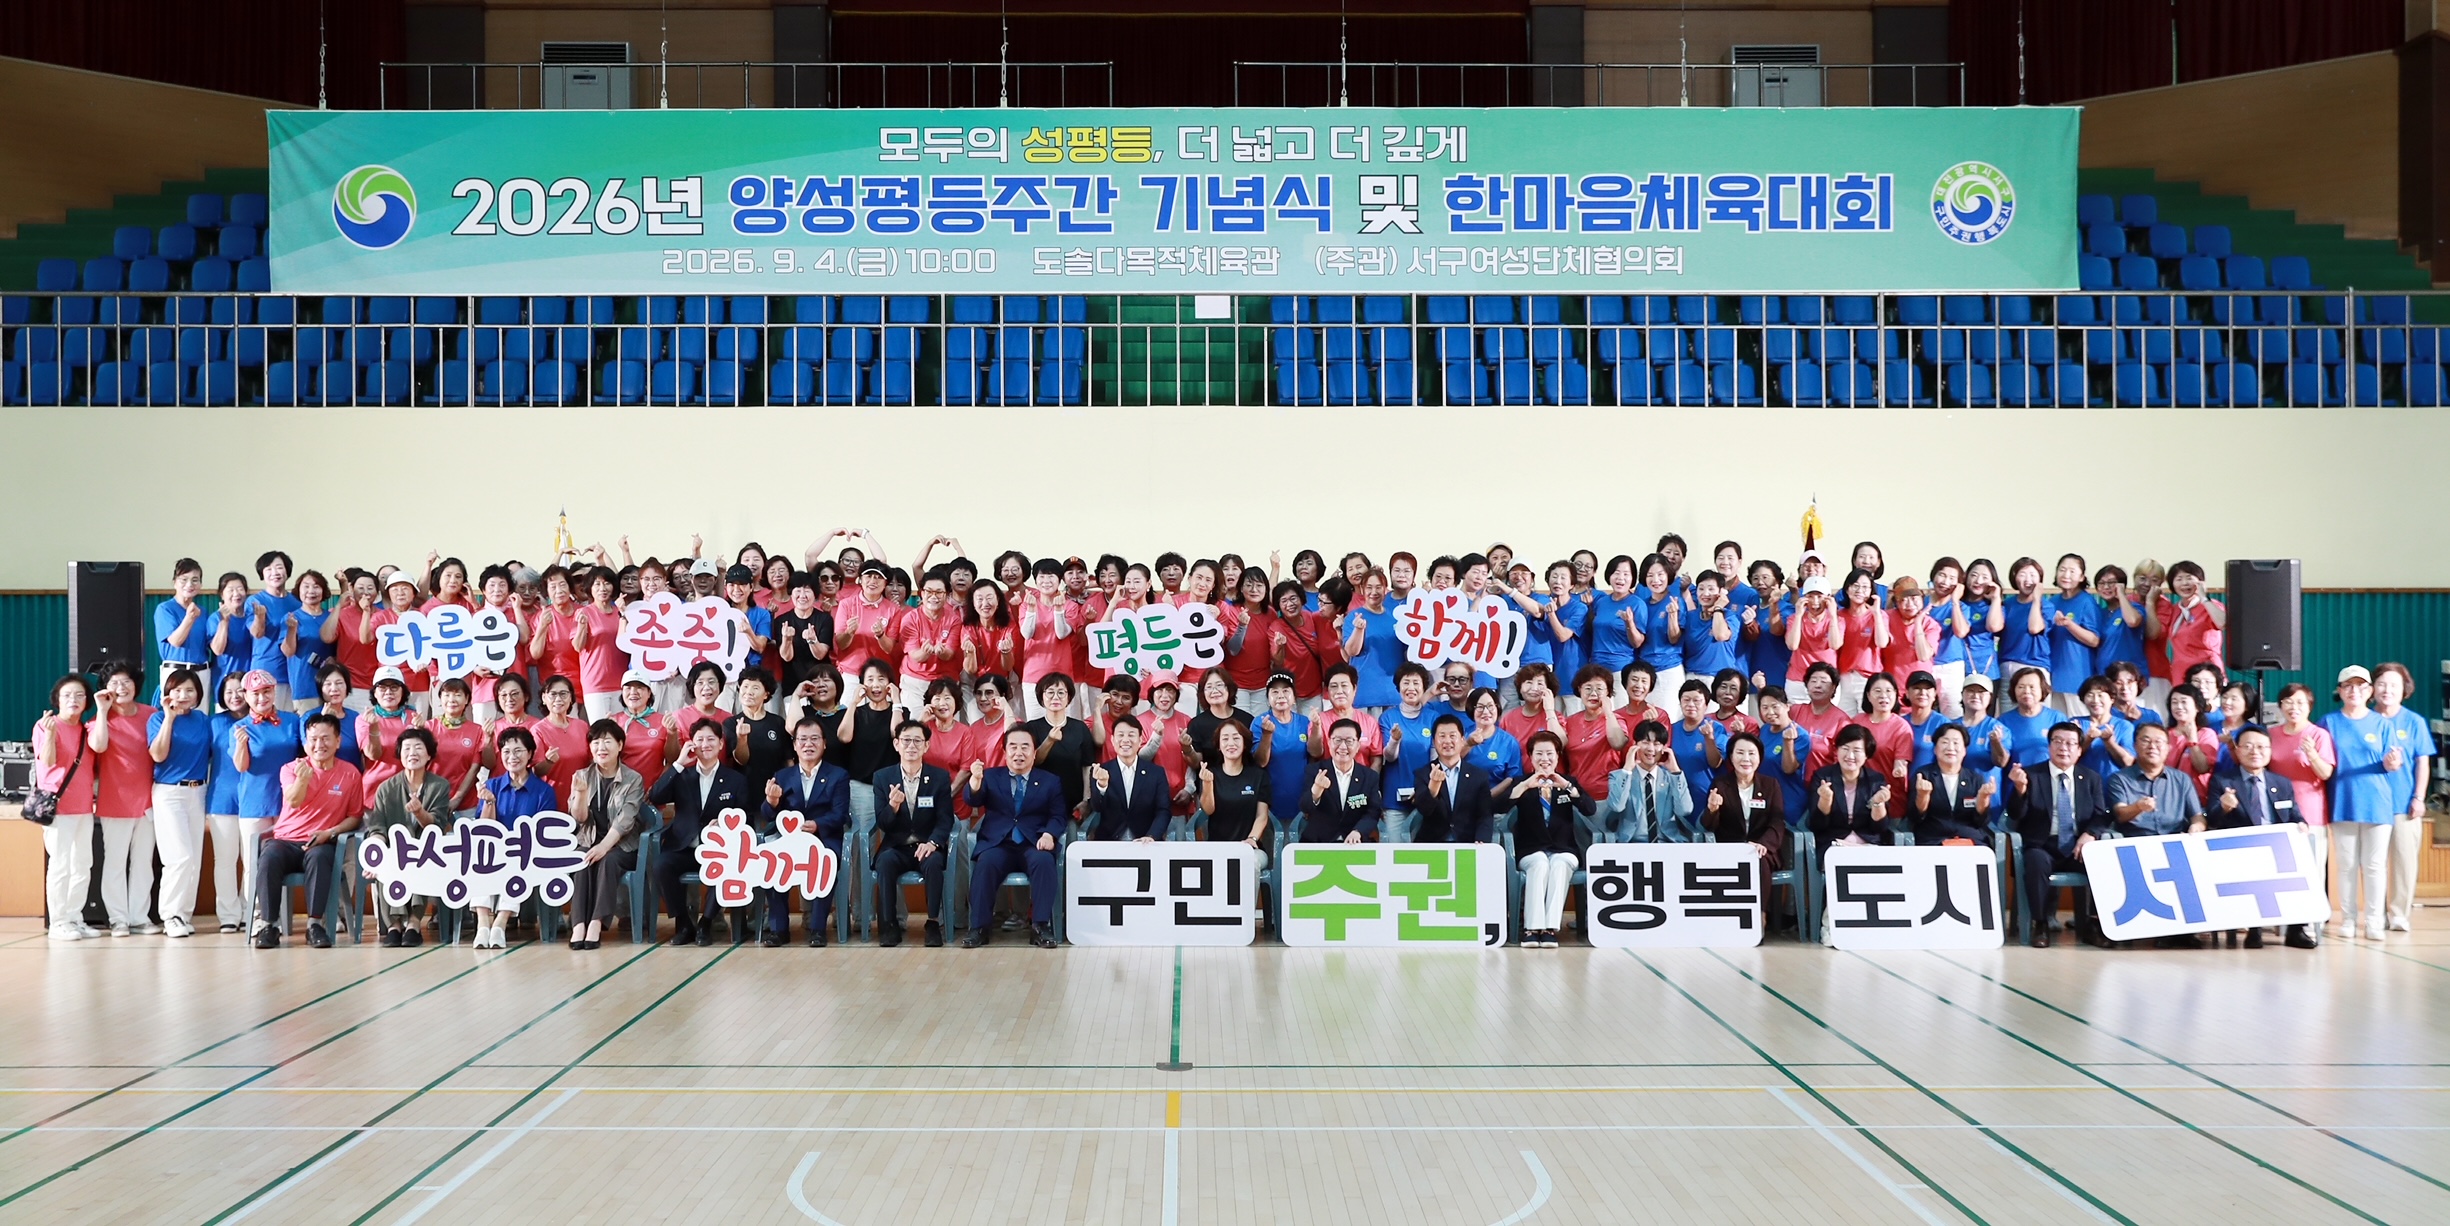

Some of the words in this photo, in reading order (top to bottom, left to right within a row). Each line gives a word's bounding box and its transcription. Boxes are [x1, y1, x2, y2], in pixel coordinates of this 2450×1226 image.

[879, 127, 1009, 163] 모두의
[1021, 126, 1165, 164] 성평등,
[1177, 126, 1219, 163] 더
[1231, 126, 1316, 163] 넓고
[1329, 126, 1371, 163] 더
[1382, 126, 1468, 163] 깊게
[450, 176, 704, 236] 2026년
[728, 174, 1121, 236] 양성평등주간
[1138, 174, 1333, 235] 기념식
[1357, 174, 1424, 235] 및
[1443, 172, 1894, 235] 한마음체육대회
[661, 248, 765, 275] 2026.
[772, 248, 805, 274] 9.
[904, 247, 998, 275] 10:00
[1032, 244, 1281, 277] 도솔다목적체육관
[1314, 245, 1399, 277] (주관)
[1406, 244, 1684, 277] 서구여성단체협의회
[384, 612, 511, 671] 다름은
[628, 609, 736, 672] 존중!
[1093, 611, 1228, 675] 평등은
[1404, 597, 1519, 669] 함께!
[364, 816, 584, 902] 양성평등
[700, 830, 832, 901] 함께
[1078, 858, 1243, 926] 구민
[1289, 849, 1500, 947] 주권,
[1589, 859, 1758, 931] 행복
[1834, 863, 1995, 931] 도시
[2113, 832, 2310, 926] 서구
